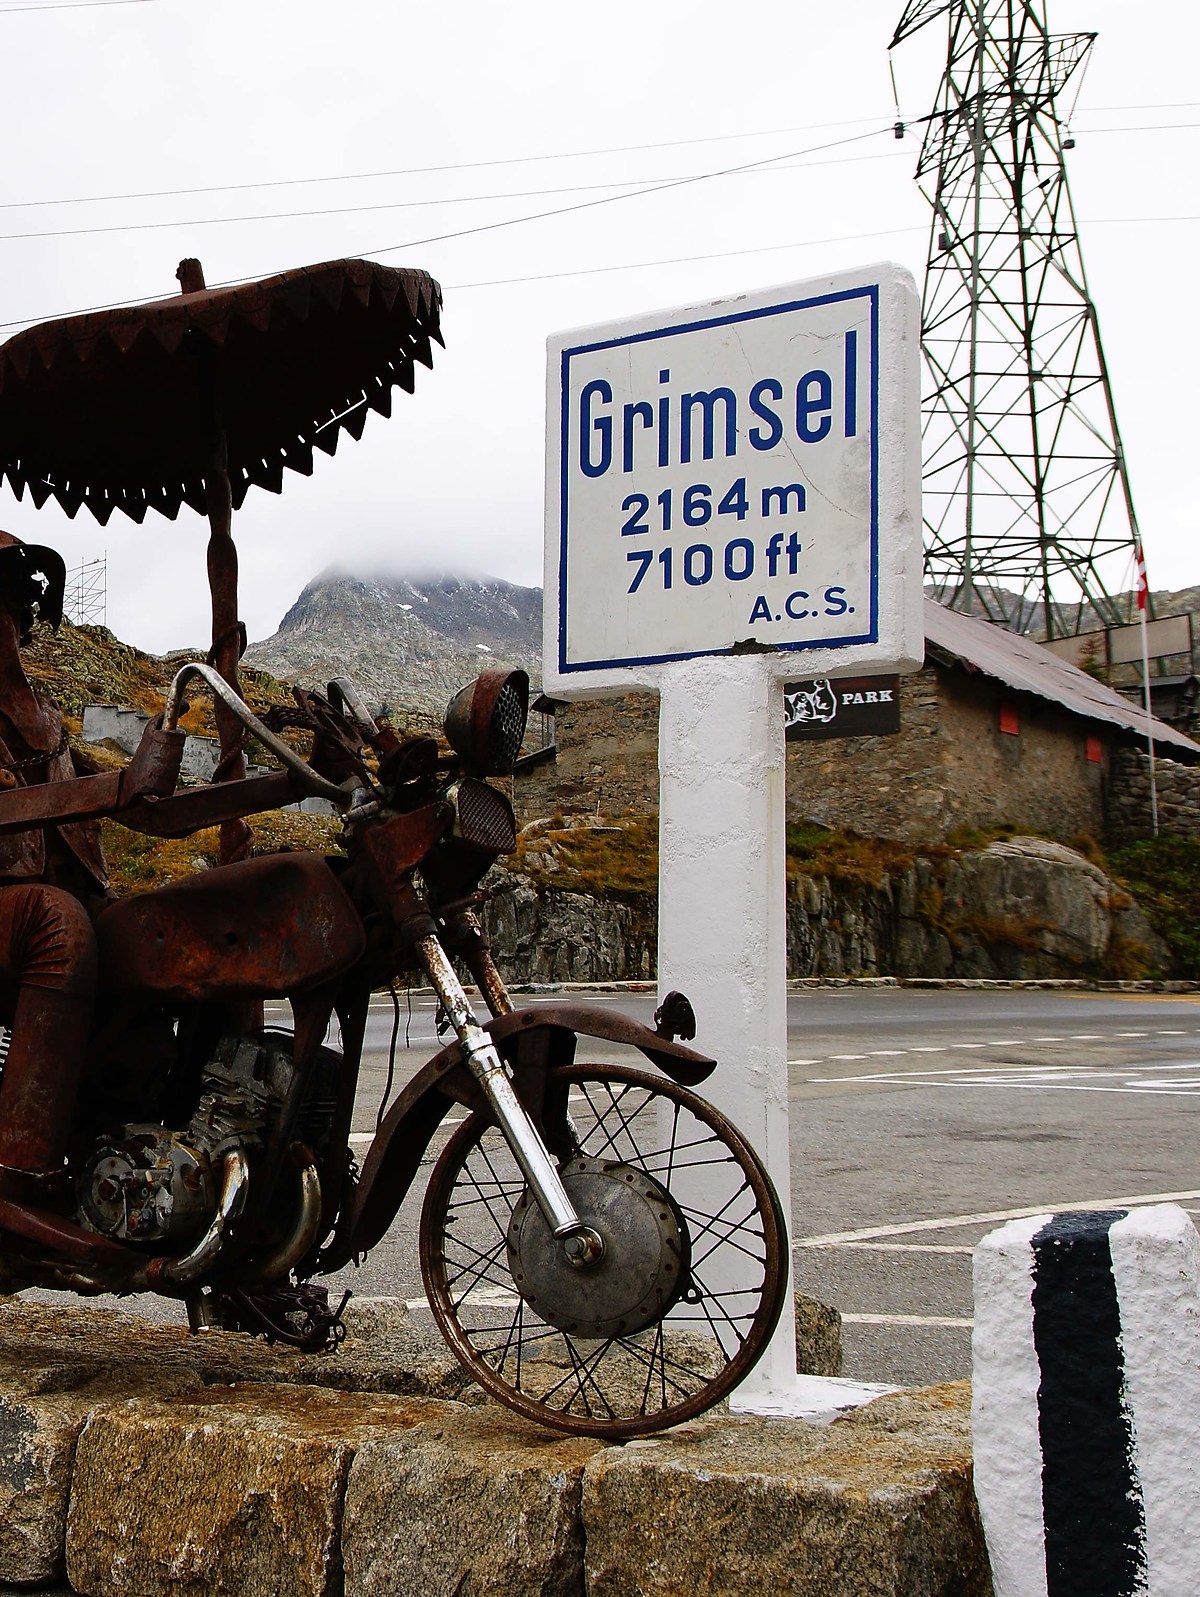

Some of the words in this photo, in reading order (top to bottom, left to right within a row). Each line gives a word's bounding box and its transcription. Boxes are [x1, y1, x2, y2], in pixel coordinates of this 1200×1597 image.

[579, 329, 858, 478] Grimsel
[748, 586, 855, 624] A.C.S.
[841, 689, 894, 706] PARK
